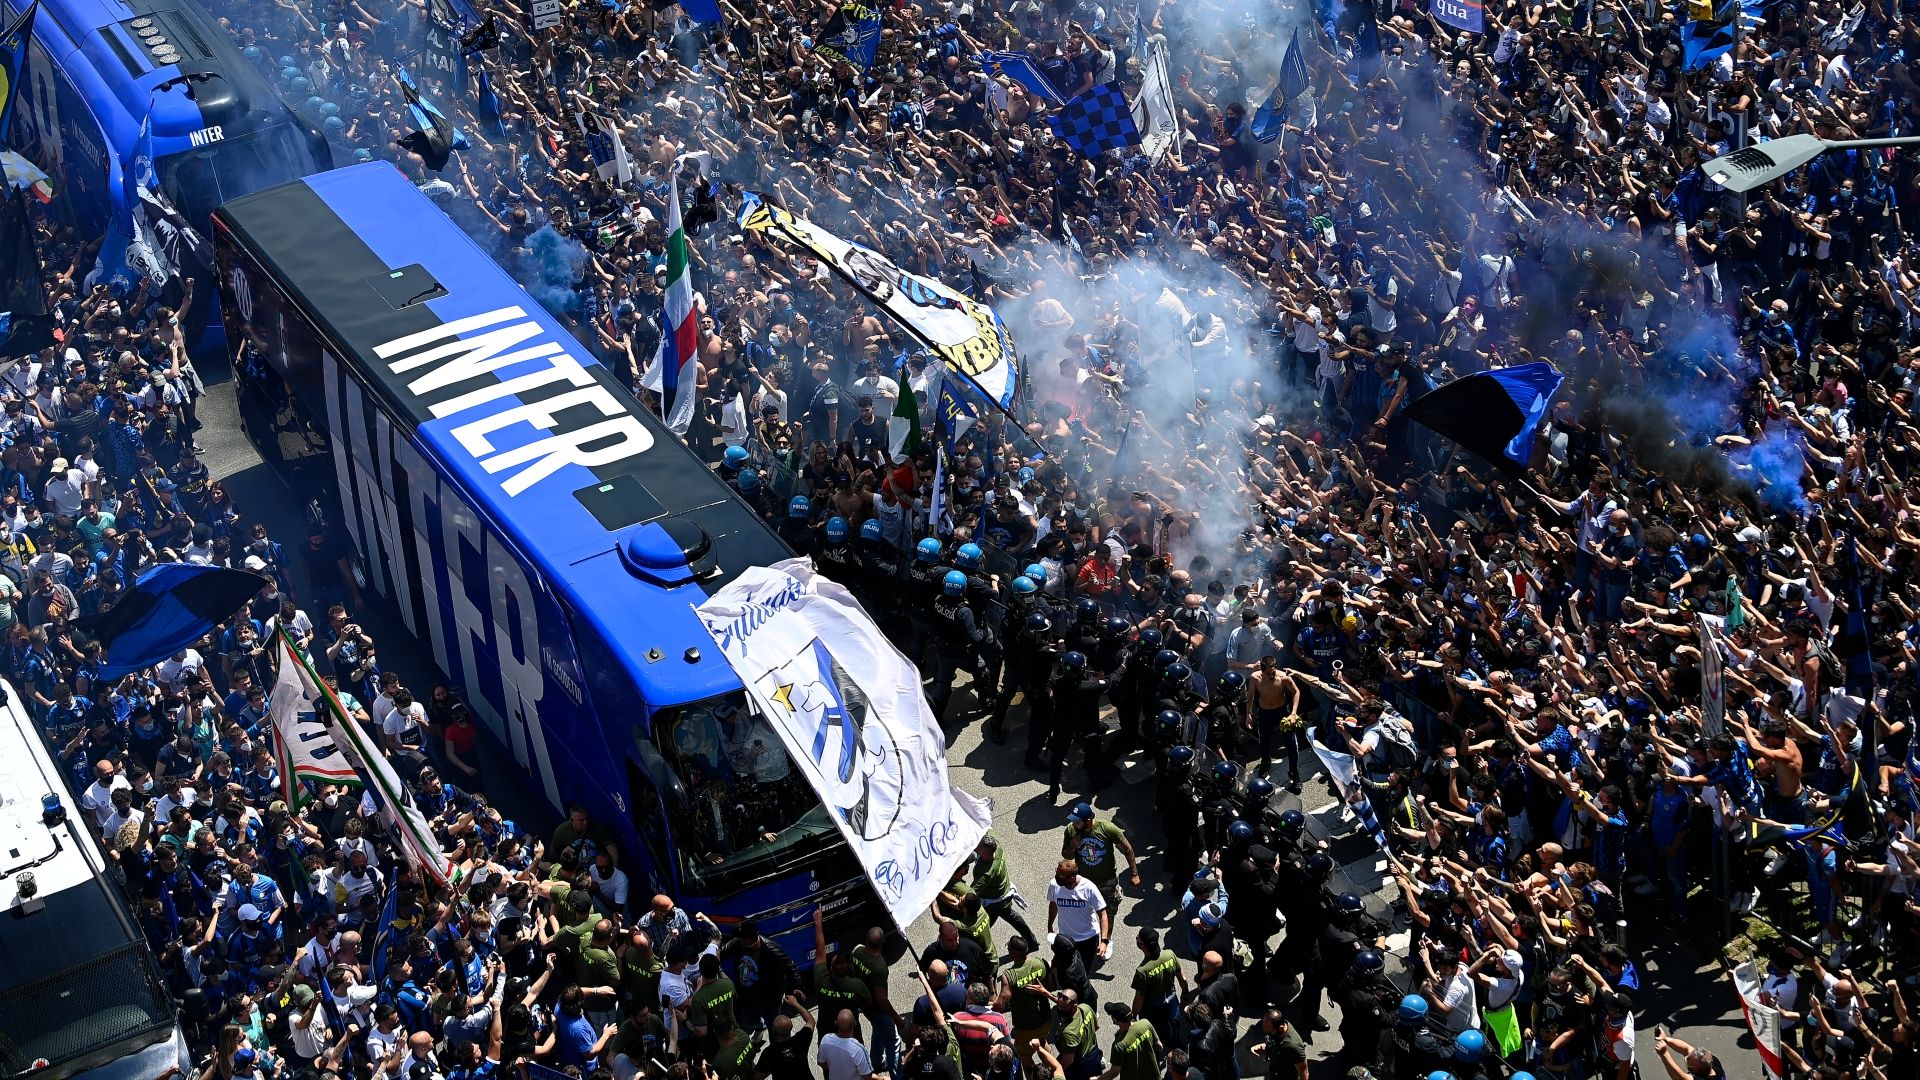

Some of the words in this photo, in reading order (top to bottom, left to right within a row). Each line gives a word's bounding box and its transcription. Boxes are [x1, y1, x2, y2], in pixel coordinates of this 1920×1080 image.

[189, 125, 225, 148] INTER
[371, 304, 656, 498] INTER
[863, 524, 880, 533] POLIZIA
[322, 345, 566, 820] INTER
[934, 602, 955, 621] POLIZIA
[1016, 968, 1044, 988] STAFF
[1147, 958, 1175, 978] STAFF
[707, 991, 737, 1009] STAFF
[1125, 1029, 1153, 1054] STAFF
[736, 1041, 754, 1066] STAFF
